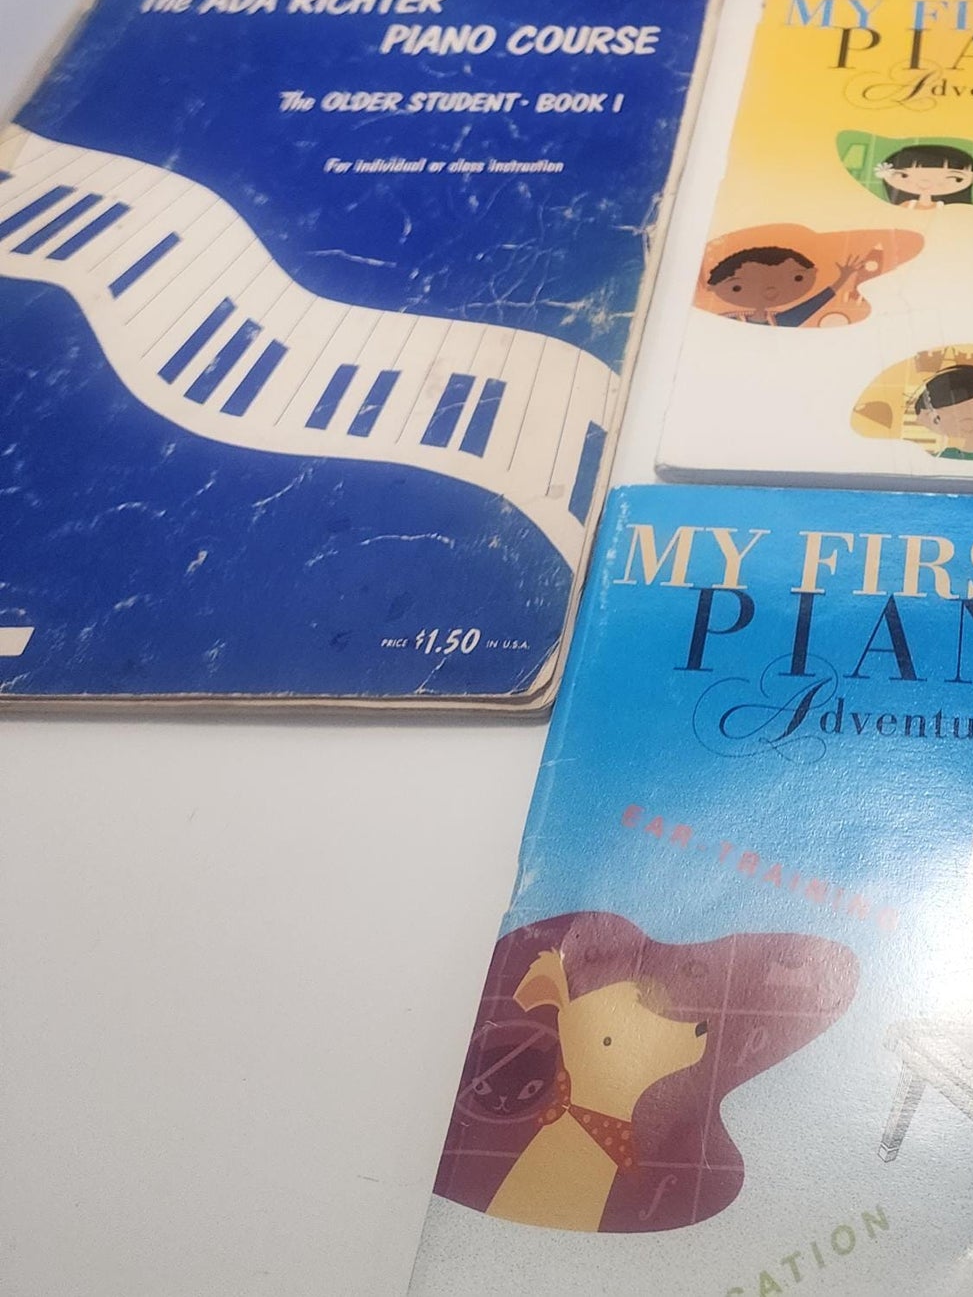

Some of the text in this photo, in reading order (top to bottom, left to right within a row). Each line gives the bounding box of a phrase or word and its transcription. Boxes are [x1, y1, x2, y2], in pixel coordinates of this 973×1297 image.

[381, 25, 661, 56] PIANO COURSE
[279, 91, 315, 113] The
[321, 91, 404, 113] OLDER
[535, 92, 609, 113] BOOK
[324, 158, 353, 173] For
[429, 161, 446, 173] or
[613, 523, 771, 590] MY
[381, 639, 408, 648] PRICE
[415, 628, 481, 654] $1.50
[486, 640, 498, 649] IN
